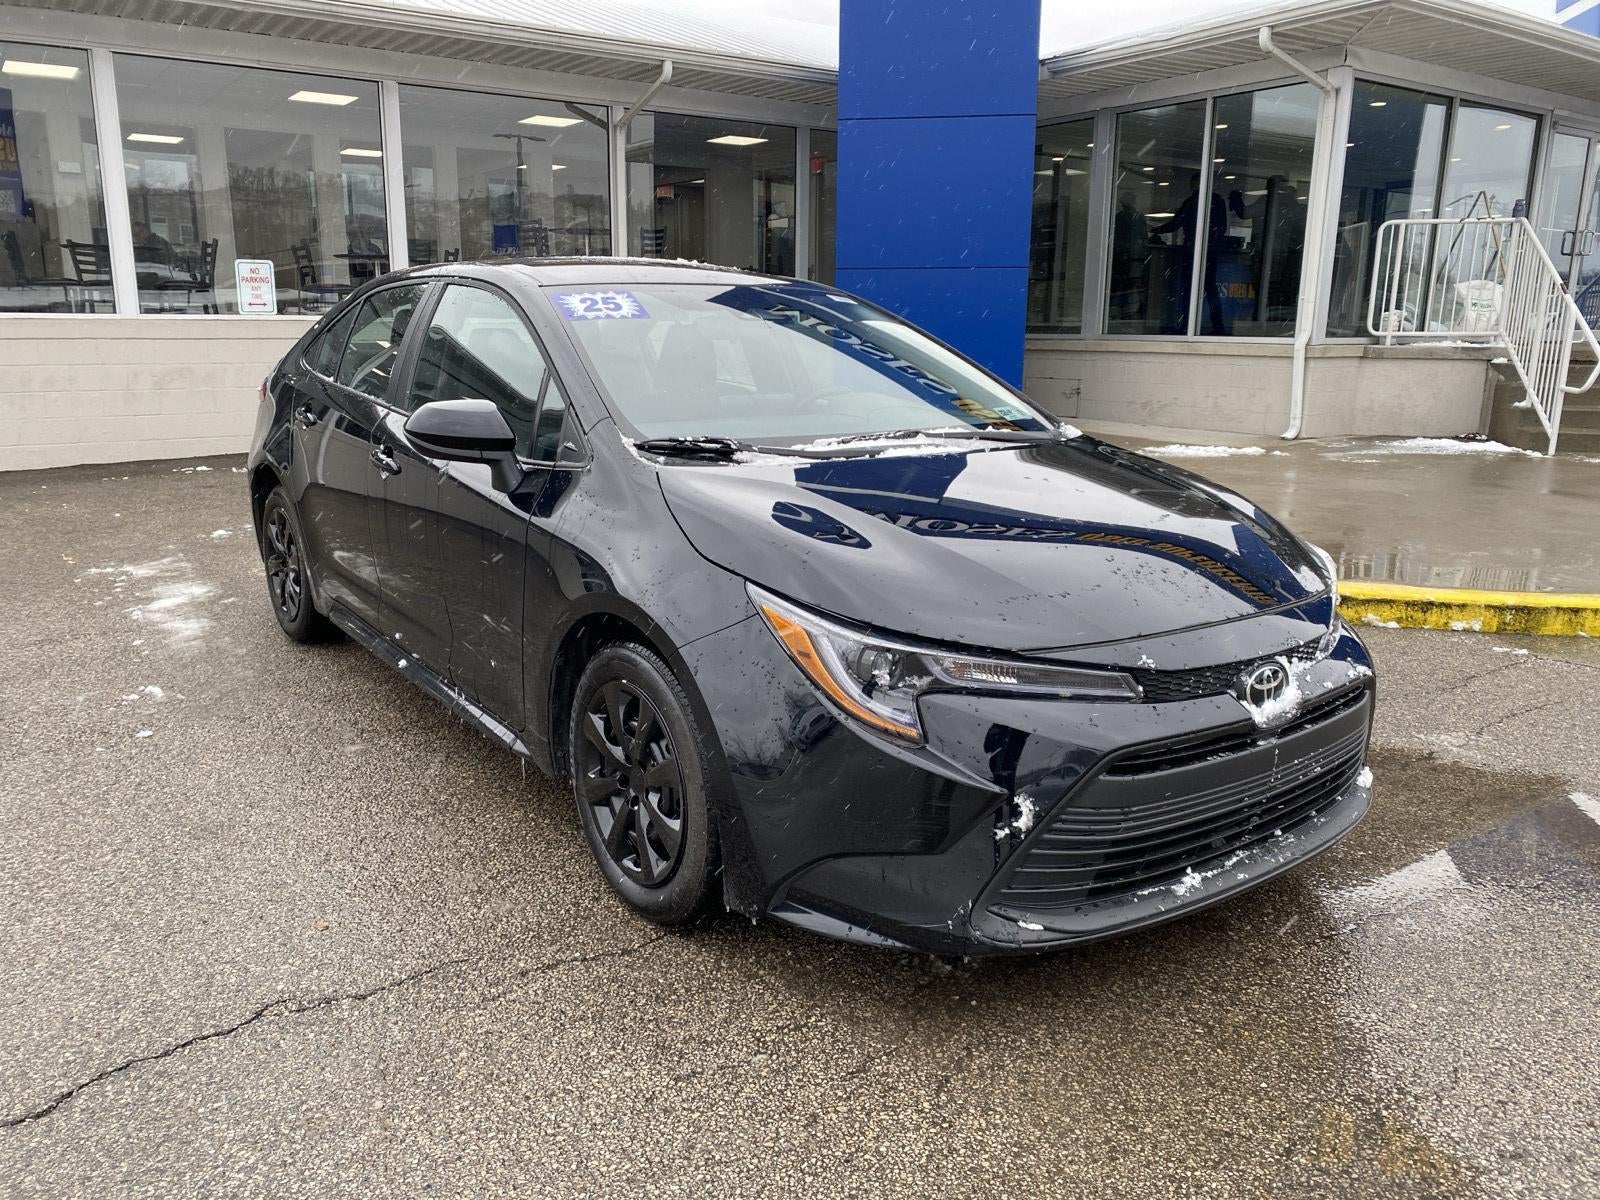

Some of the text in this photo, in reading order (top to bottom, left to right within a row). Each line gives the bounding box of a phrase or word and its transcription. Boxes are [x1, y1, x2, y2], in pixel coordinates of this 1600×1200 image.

[249, 267, 260, 275] NO
[240, 276, 270, 284] PARKING
[579, 296, 623, 312] 25
